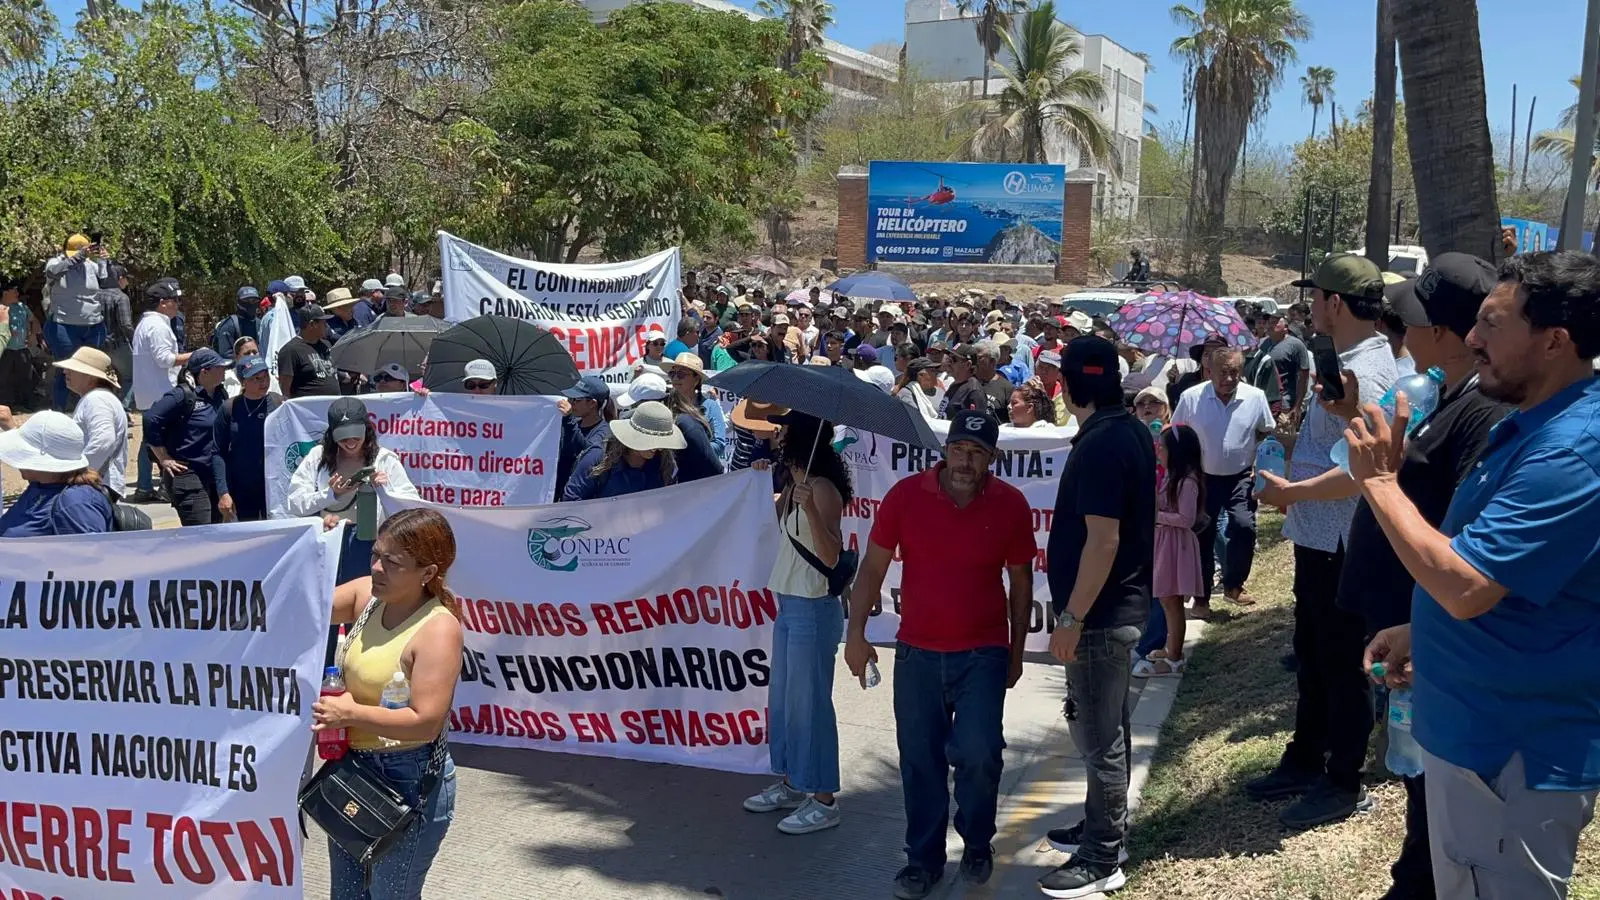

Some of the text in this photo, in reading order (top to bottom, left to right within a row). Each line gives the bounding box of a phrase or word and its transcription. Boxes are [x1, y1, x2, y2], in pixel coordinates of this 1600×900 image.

[876, 216, 967, 233] HELICÓPTERO
[877, 208, 915, 217] TOUR EN
[922, 247, 940, 255] 5467
[507, 268, 528, 290] EL
[535, 270, 637, 294] CONTRABANDO
[480, 295, 565, 322] CAMARÓN
[566, 297, 604, 323] ESTÁ
[367, 412, 503, 439] Solicitamos su
[478, 451, 544, 475] directa
[841, 451, 879, 465] NPAC
[892, 442, 1053, 478] PRENTA:
[461, 488, 505, 506] para:
[544, 536, 630, 559] CONPAC
[39, 571, 141, 630] ÚNICA
[148, 579, 267, 632] MEDIDA
[591, 579, 778, 635] REMOCIÓN
[460, 645, 770, 694] DE FUNCIONARIOS
[0, 658, 301, 716] PRESERVAR LA PLANTA
[568, 711, 618, 744] EN
[620, 707, 770, 747] SENASIC
[91, 733, 221, 787] NACIONAL
[227, 743, 258, 792] ES
[0, 802, 135, 883] IERRE
